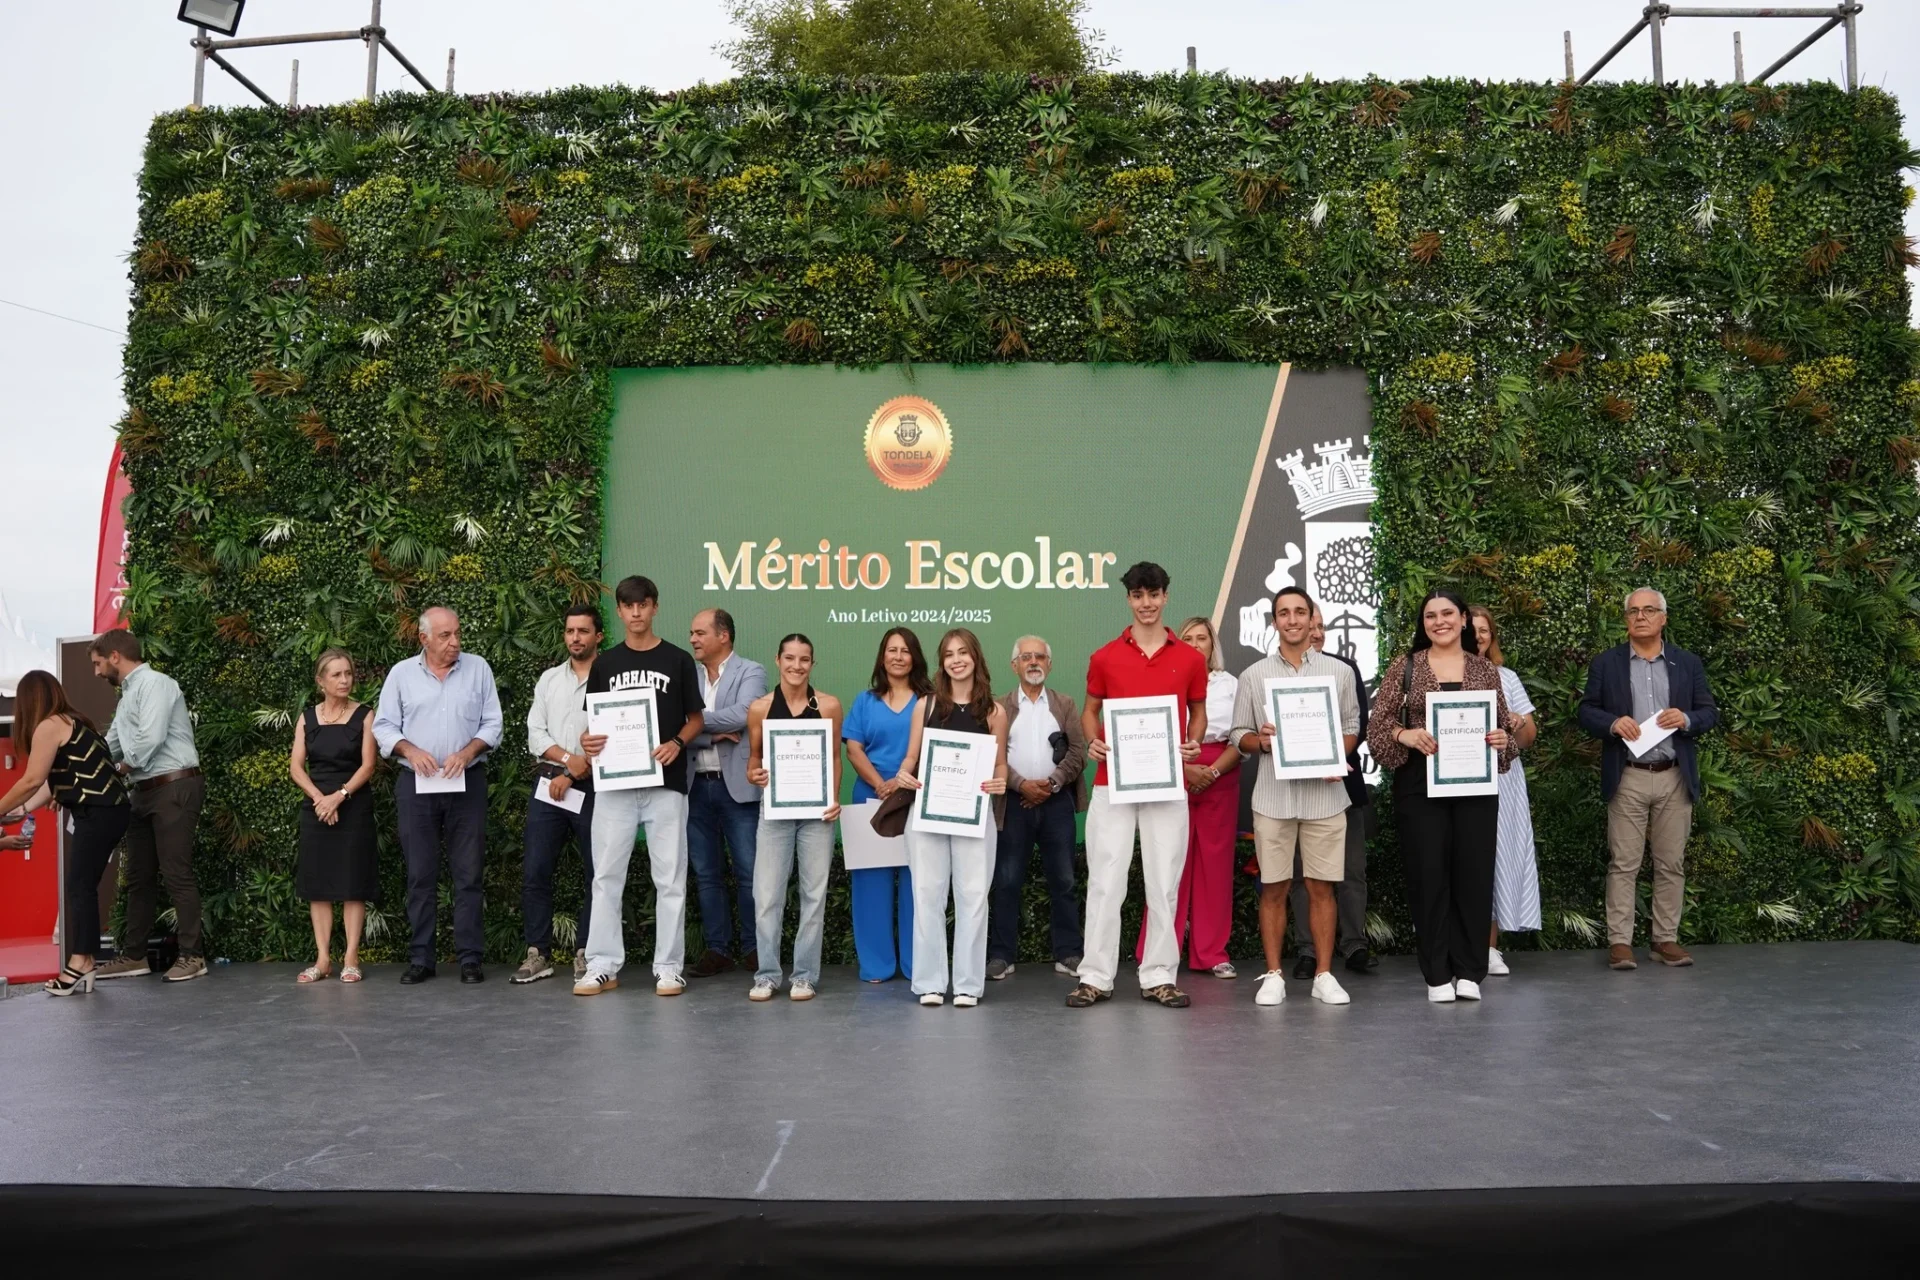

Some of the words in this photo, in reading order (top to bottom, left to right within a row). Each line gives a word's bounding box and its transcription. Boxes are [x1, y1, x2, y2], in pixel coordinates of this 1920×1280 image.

[703, 537, 892, 591] Mérito
[904, 535, 1117, 590] Escolar
[827, 608, 858, 623] Ano
[861, 608, 908, 623] Letivo
[910, 608, 992, 625] 2024/2025
[609, 670, 671, 694] CARHARTT
[1281, 711, 1327, 721] CERTIFICADO
[615, 723, 646, 732] TIFICADO
[1439, 727, 1485, 736] CERTIFICADO
[1119, 731, 1167, 742] CERTIFICADO
[776, 753, 821, 761] CERTIFICADO
[933, 765, 968, 775] CERTIFIC
